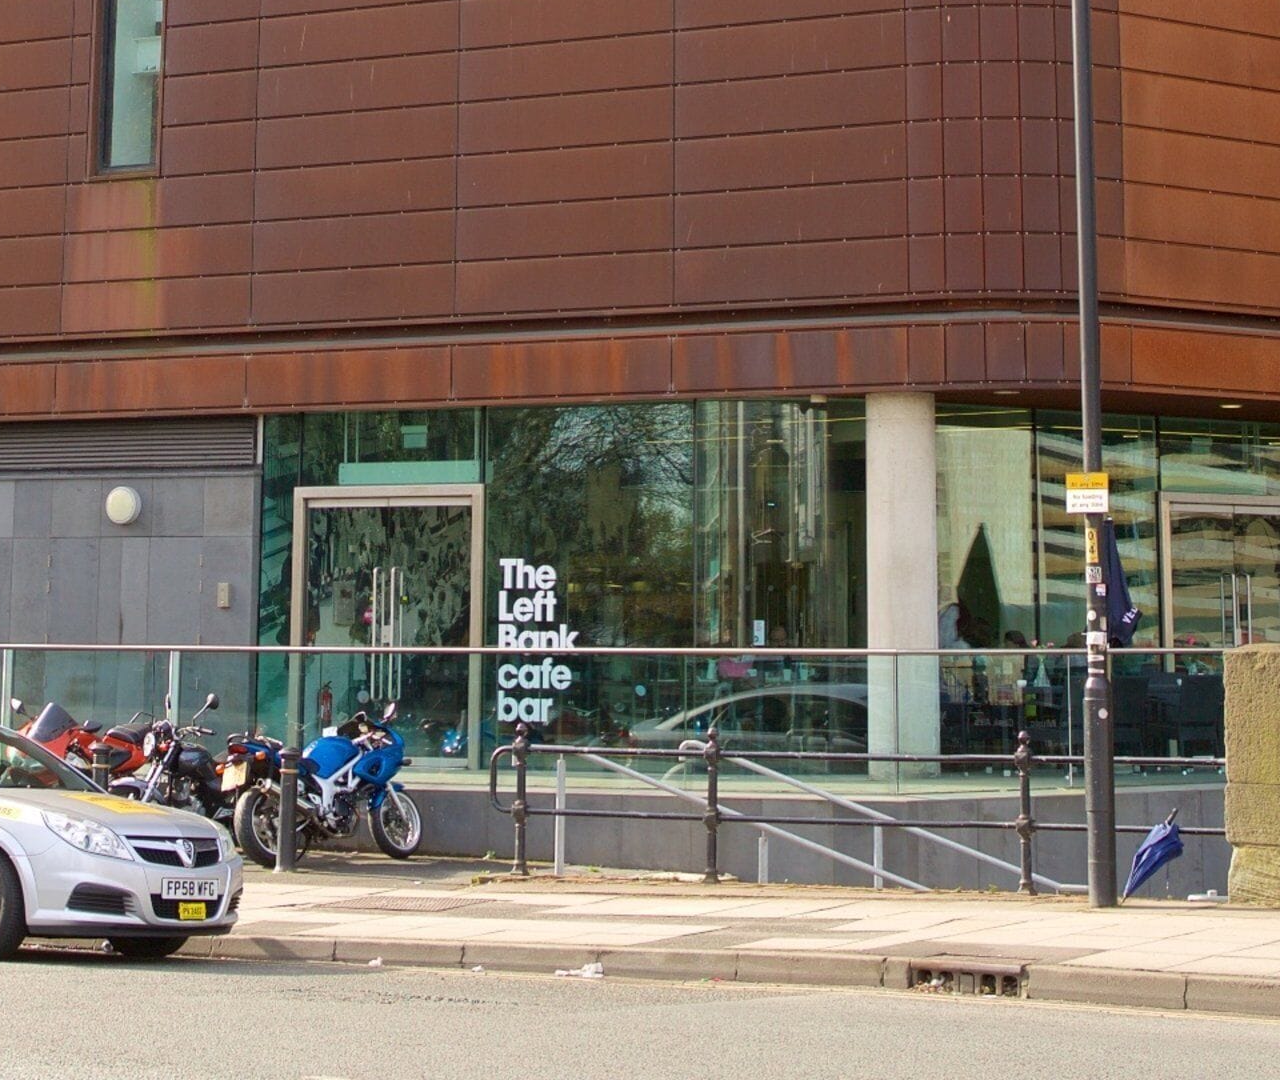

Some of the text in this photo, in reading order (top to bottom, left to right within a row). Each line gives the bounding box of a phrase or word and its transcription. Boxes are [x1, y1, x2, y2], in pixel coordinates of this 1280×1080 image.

[499, 558, 557, 589] The
[498, 590, 557, 622] Left
[497, 623, 580, 656] Bank
[497, 656, 572, 690] cafe
[496, 690, 554, 723] bar
[167, 880, 195, 896] FP58
